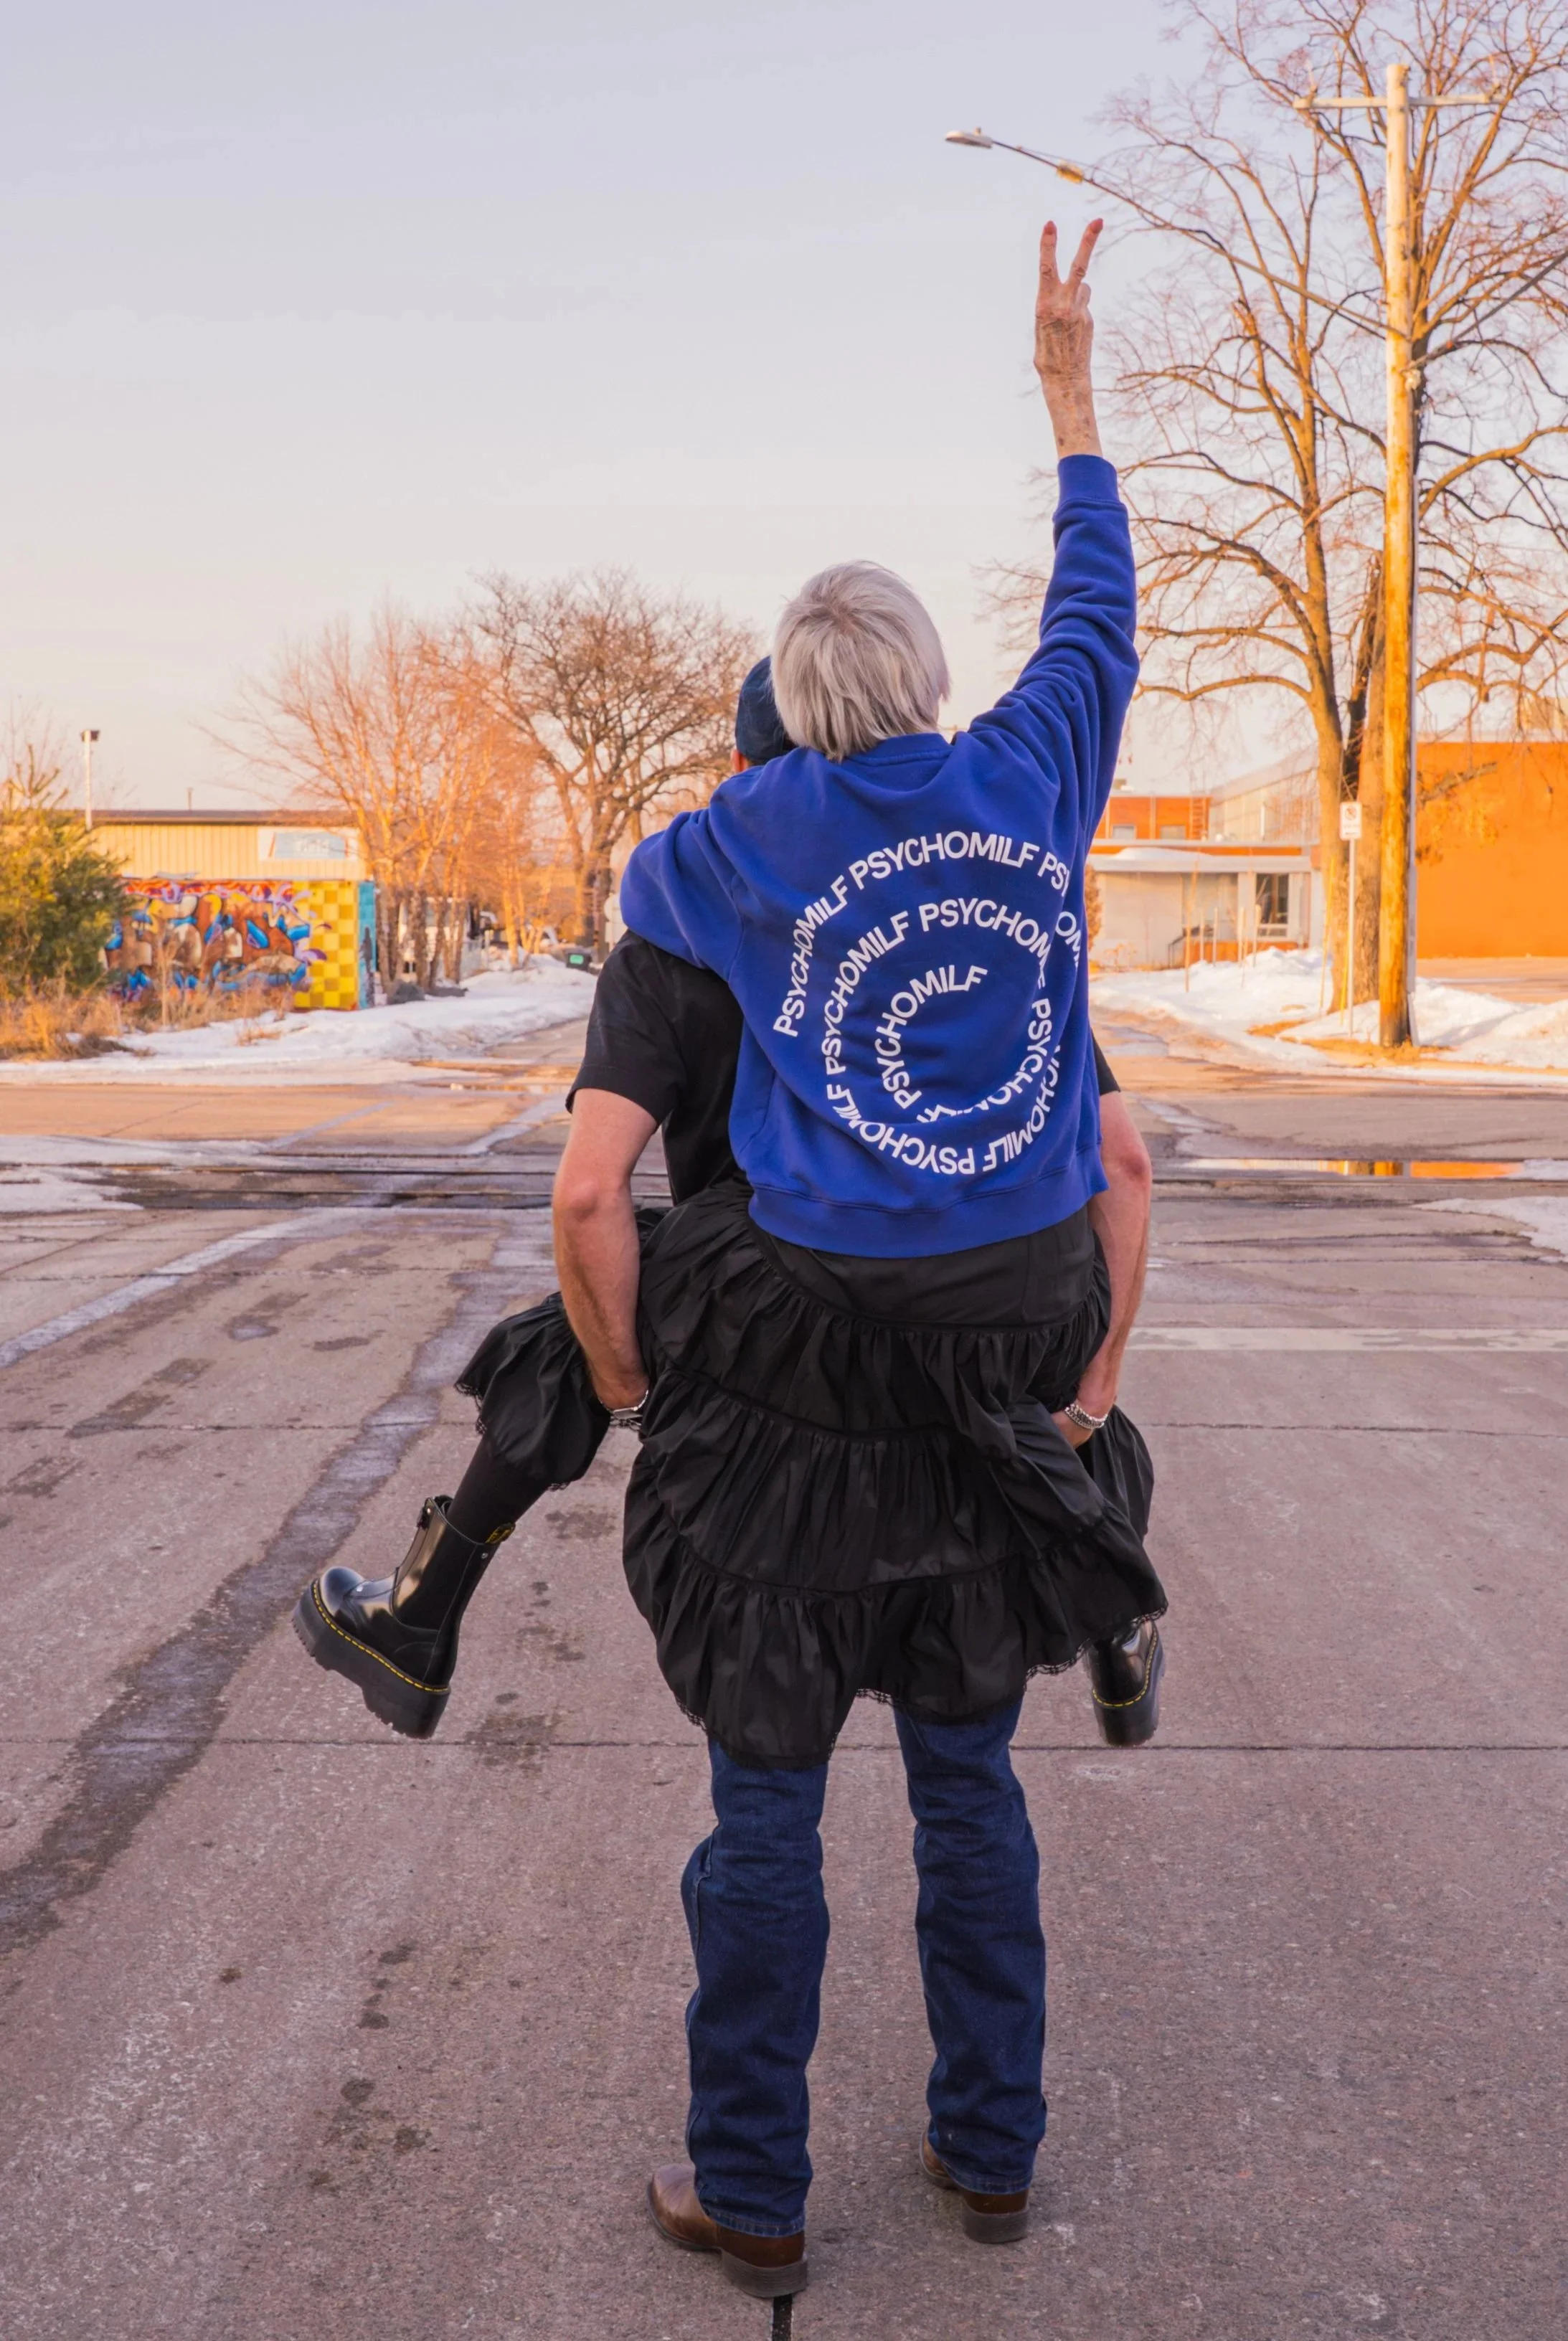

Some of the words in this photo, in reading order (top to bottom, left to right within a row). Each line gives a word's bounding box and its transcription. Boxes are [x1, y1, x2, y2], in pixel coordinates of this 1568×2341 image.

[849, 831, 1040, 890] PSYCHOMILF
[773, 875, 848, 1037] PSYCHOMILF
[821, 910, 909, 1075] PSYCHOMILF
[874, 965, 988, 1110] PSYCHOMILF
